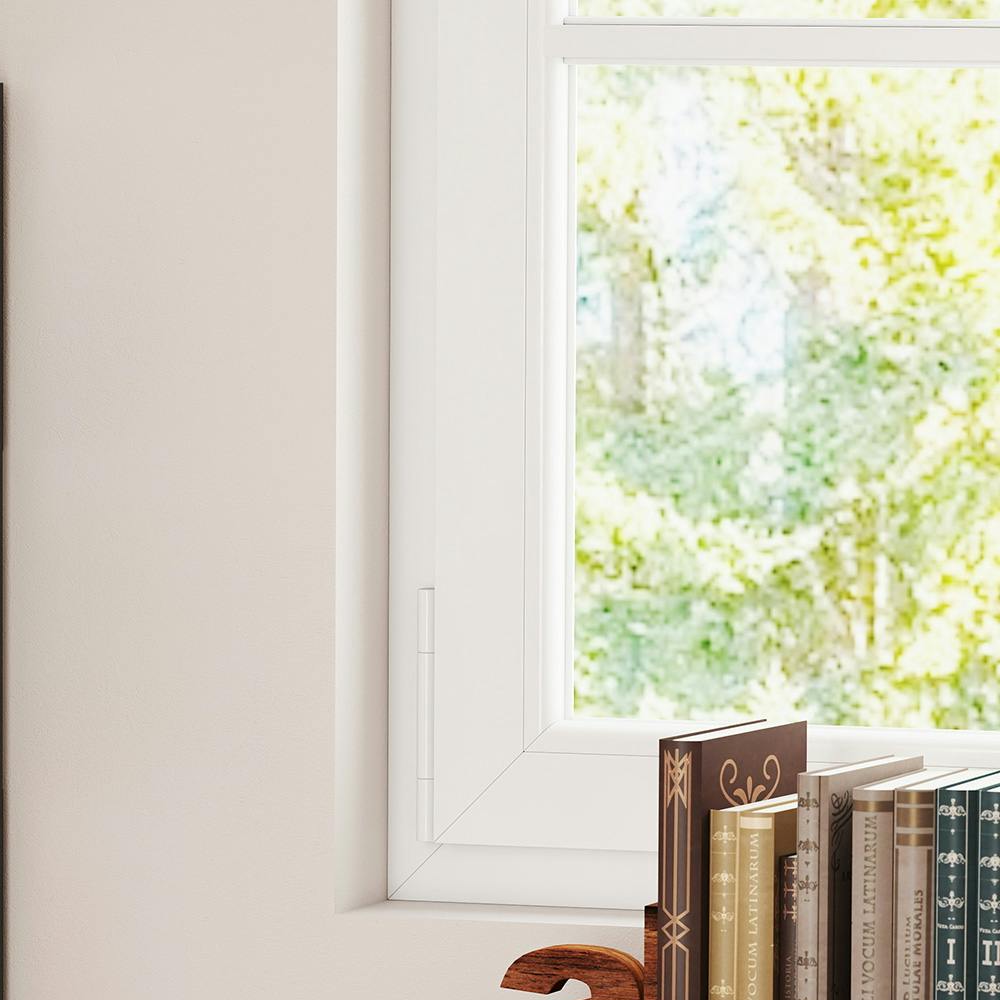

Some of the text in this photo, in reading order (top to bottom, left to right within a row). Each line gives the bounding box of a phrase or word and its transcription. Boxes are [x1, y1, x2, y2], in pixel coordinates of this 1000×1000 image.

[748, 832, 760, 935] LATINARUM
[863, 815, 878, 914] LATINARUM
[861, 920, 876, 984] VOCUM
[912, 889, 924, 956] MORALES
